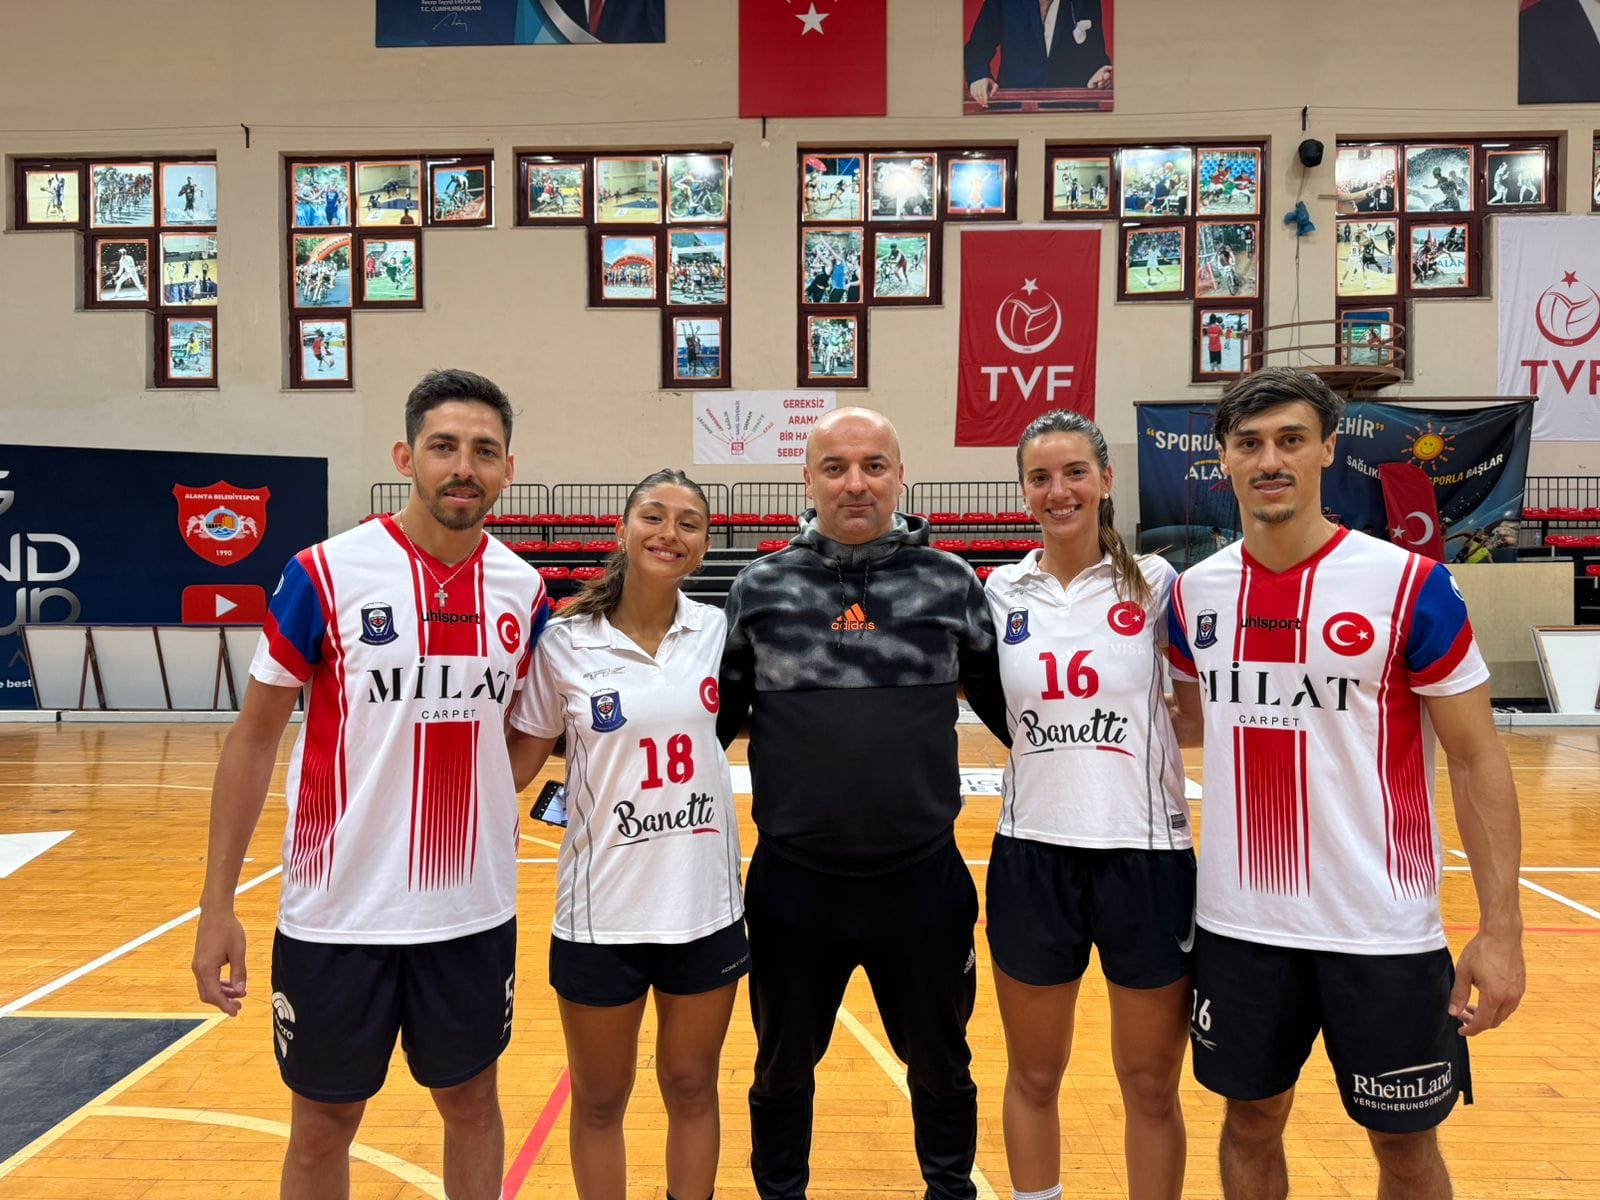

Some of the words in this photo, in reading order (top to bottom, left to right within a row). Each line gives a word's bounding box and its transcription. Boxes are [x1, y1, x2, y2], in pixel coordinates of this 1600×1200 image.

[981, 365, 1074, 402] TVF
[783, 397, 825, 409] GEREKSİZ
[779, 429, 794, 441] BİR
[777, 448, 804, 457] SEBEP
[1465, 453, 1504, 476] BAŞLAR
[213, 493, 260, 501] BELEDİYESPOR
[421, 609, 480, 625] uhlsport
[1241, 615, 1302, 630] uhlsport
[831, 620, 876, 631] adidas
[1039, 650, 1099, 700] 16
[6, 679, 33, 688] best
[421, 709, 476, 719] CARPET
[1239, 714, 1300, 727] CARPET
[1018, 708, 1129, 747] Banetti
[639, 733, 695, 791] 18
[613, 792, 714, 839] Banetti
[1352, 1061, 1452, 1099] RheinLand
